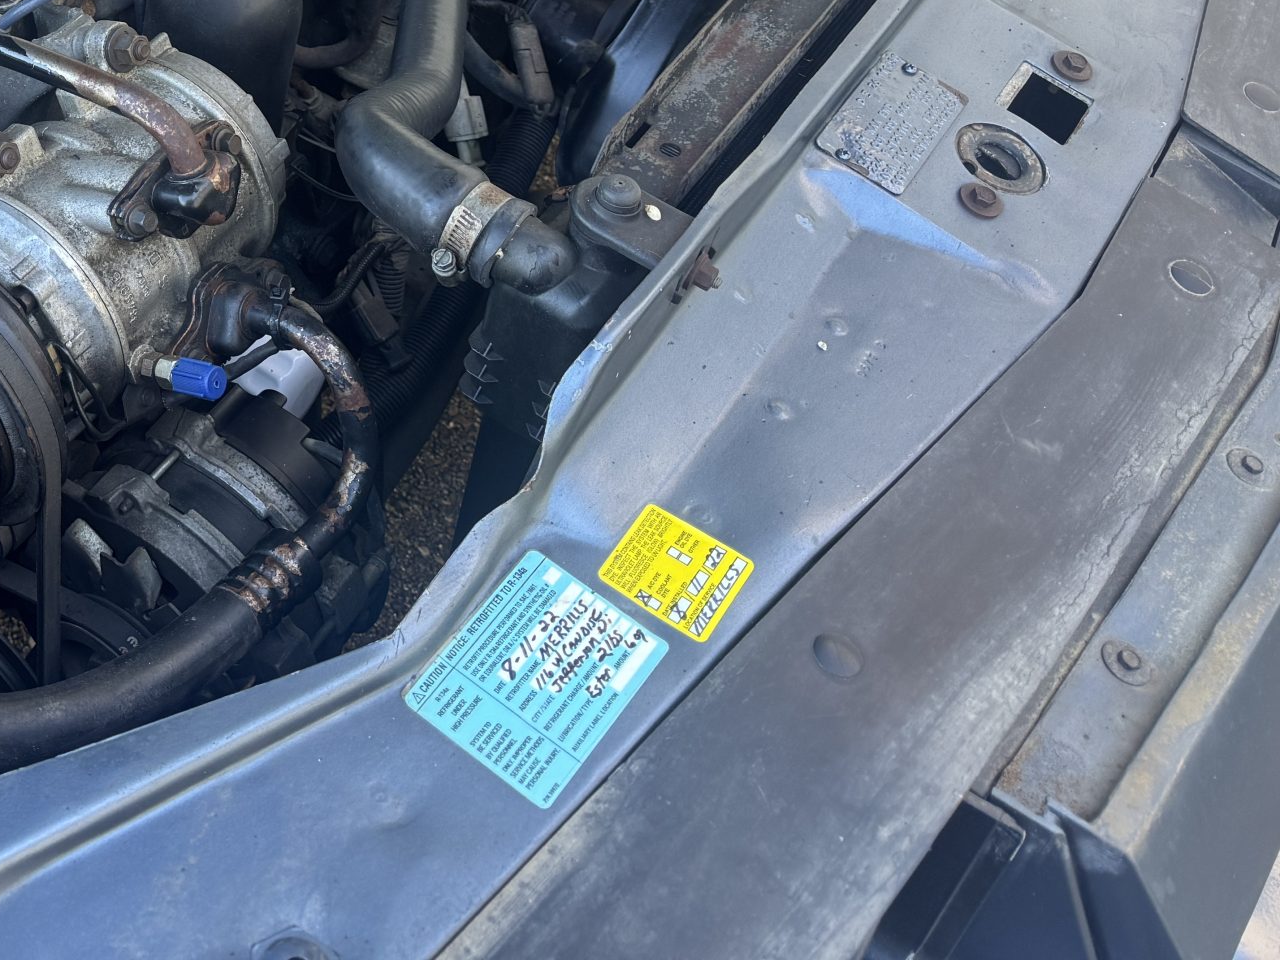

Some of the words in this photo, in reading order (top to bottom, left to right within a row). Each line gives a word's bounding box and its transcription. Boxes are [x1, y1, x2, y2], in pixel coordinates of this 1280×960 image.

[655, 573, 672, 595] COOLANT
[669, 581, 688, 605] INSTALLED
[683, 606, 700, 629] LOCATION
[701, 582, 716, 601] SERVICE
[418, 661, 447, 693] CAUTION
[444, 633, 470, 661] NOTICE:
[465, 594, 504, 635] RETROFITTED
[499, 584, 512, 596] TO
[506, 565, 528, 588] R-134a
[461, 650, 481, 671] RETROFIT
[477, 629, 499, 652] PROCEDURE
[495, 606, 518, 630] PERFORMED
[514, 600, 522, 608] TO
[470, 666, 481, 677] USE
[476, 655, 490, 669] ONLY
[494, 618, 520, 647] REFRIGERANT
[515, 611, 526, 621] AND
[522, 591, 542, 613] SYNTHETIC
[478, 673, 487, 683] OR
[514, 621, 530, 638] SYSTEM
[526, 612, 538, 624] WILL
[533, 606, 542, 615] BE
[538, 589, 557, 609] DAMAGED
[612, 649, 630, 670] AMOUNT
[493, 680, 506, 694] DATE
[504, 671, 531, 702] RETROFITTER
[526, 659, 541, 674] NAME
[436, 684, 465, 717] REFRIGERANT
[450, 698, 467, 716] UNDER
[450, 718, 463, 732] HIGH
[459, 694, 483, 720] PRESSURE
[517, 689, 538, 712] ADDRESS
[543, 698, 571, 732] REFRIGERANT
[469, 726, 487, 747] SYSTEM
[483, 720, 492, 730] TO
[476, 744, 485, 753] BE
[481, 722, 503, 746] SERVICED
[571, 726, 592, 753] AUXILIARY
[588, 712, 603, 729] LABEL
[599, 691, 619, 715] LOCATION
[485, 750, 494, 760] BY
[490, 727, 512, 753] QUALIFIED
[492, 736, 517, 766] PERSONNEL
[509, 756, 528, 779] SERVICE
[523, 735, 545, 760] METHODS
[511, 734, 532, 760] IMPROPER
[517, 772, 528, 785] MAY
[524, 756, 541, 775] CAUSE
[524, 763, 547, 790] PERSONAL
